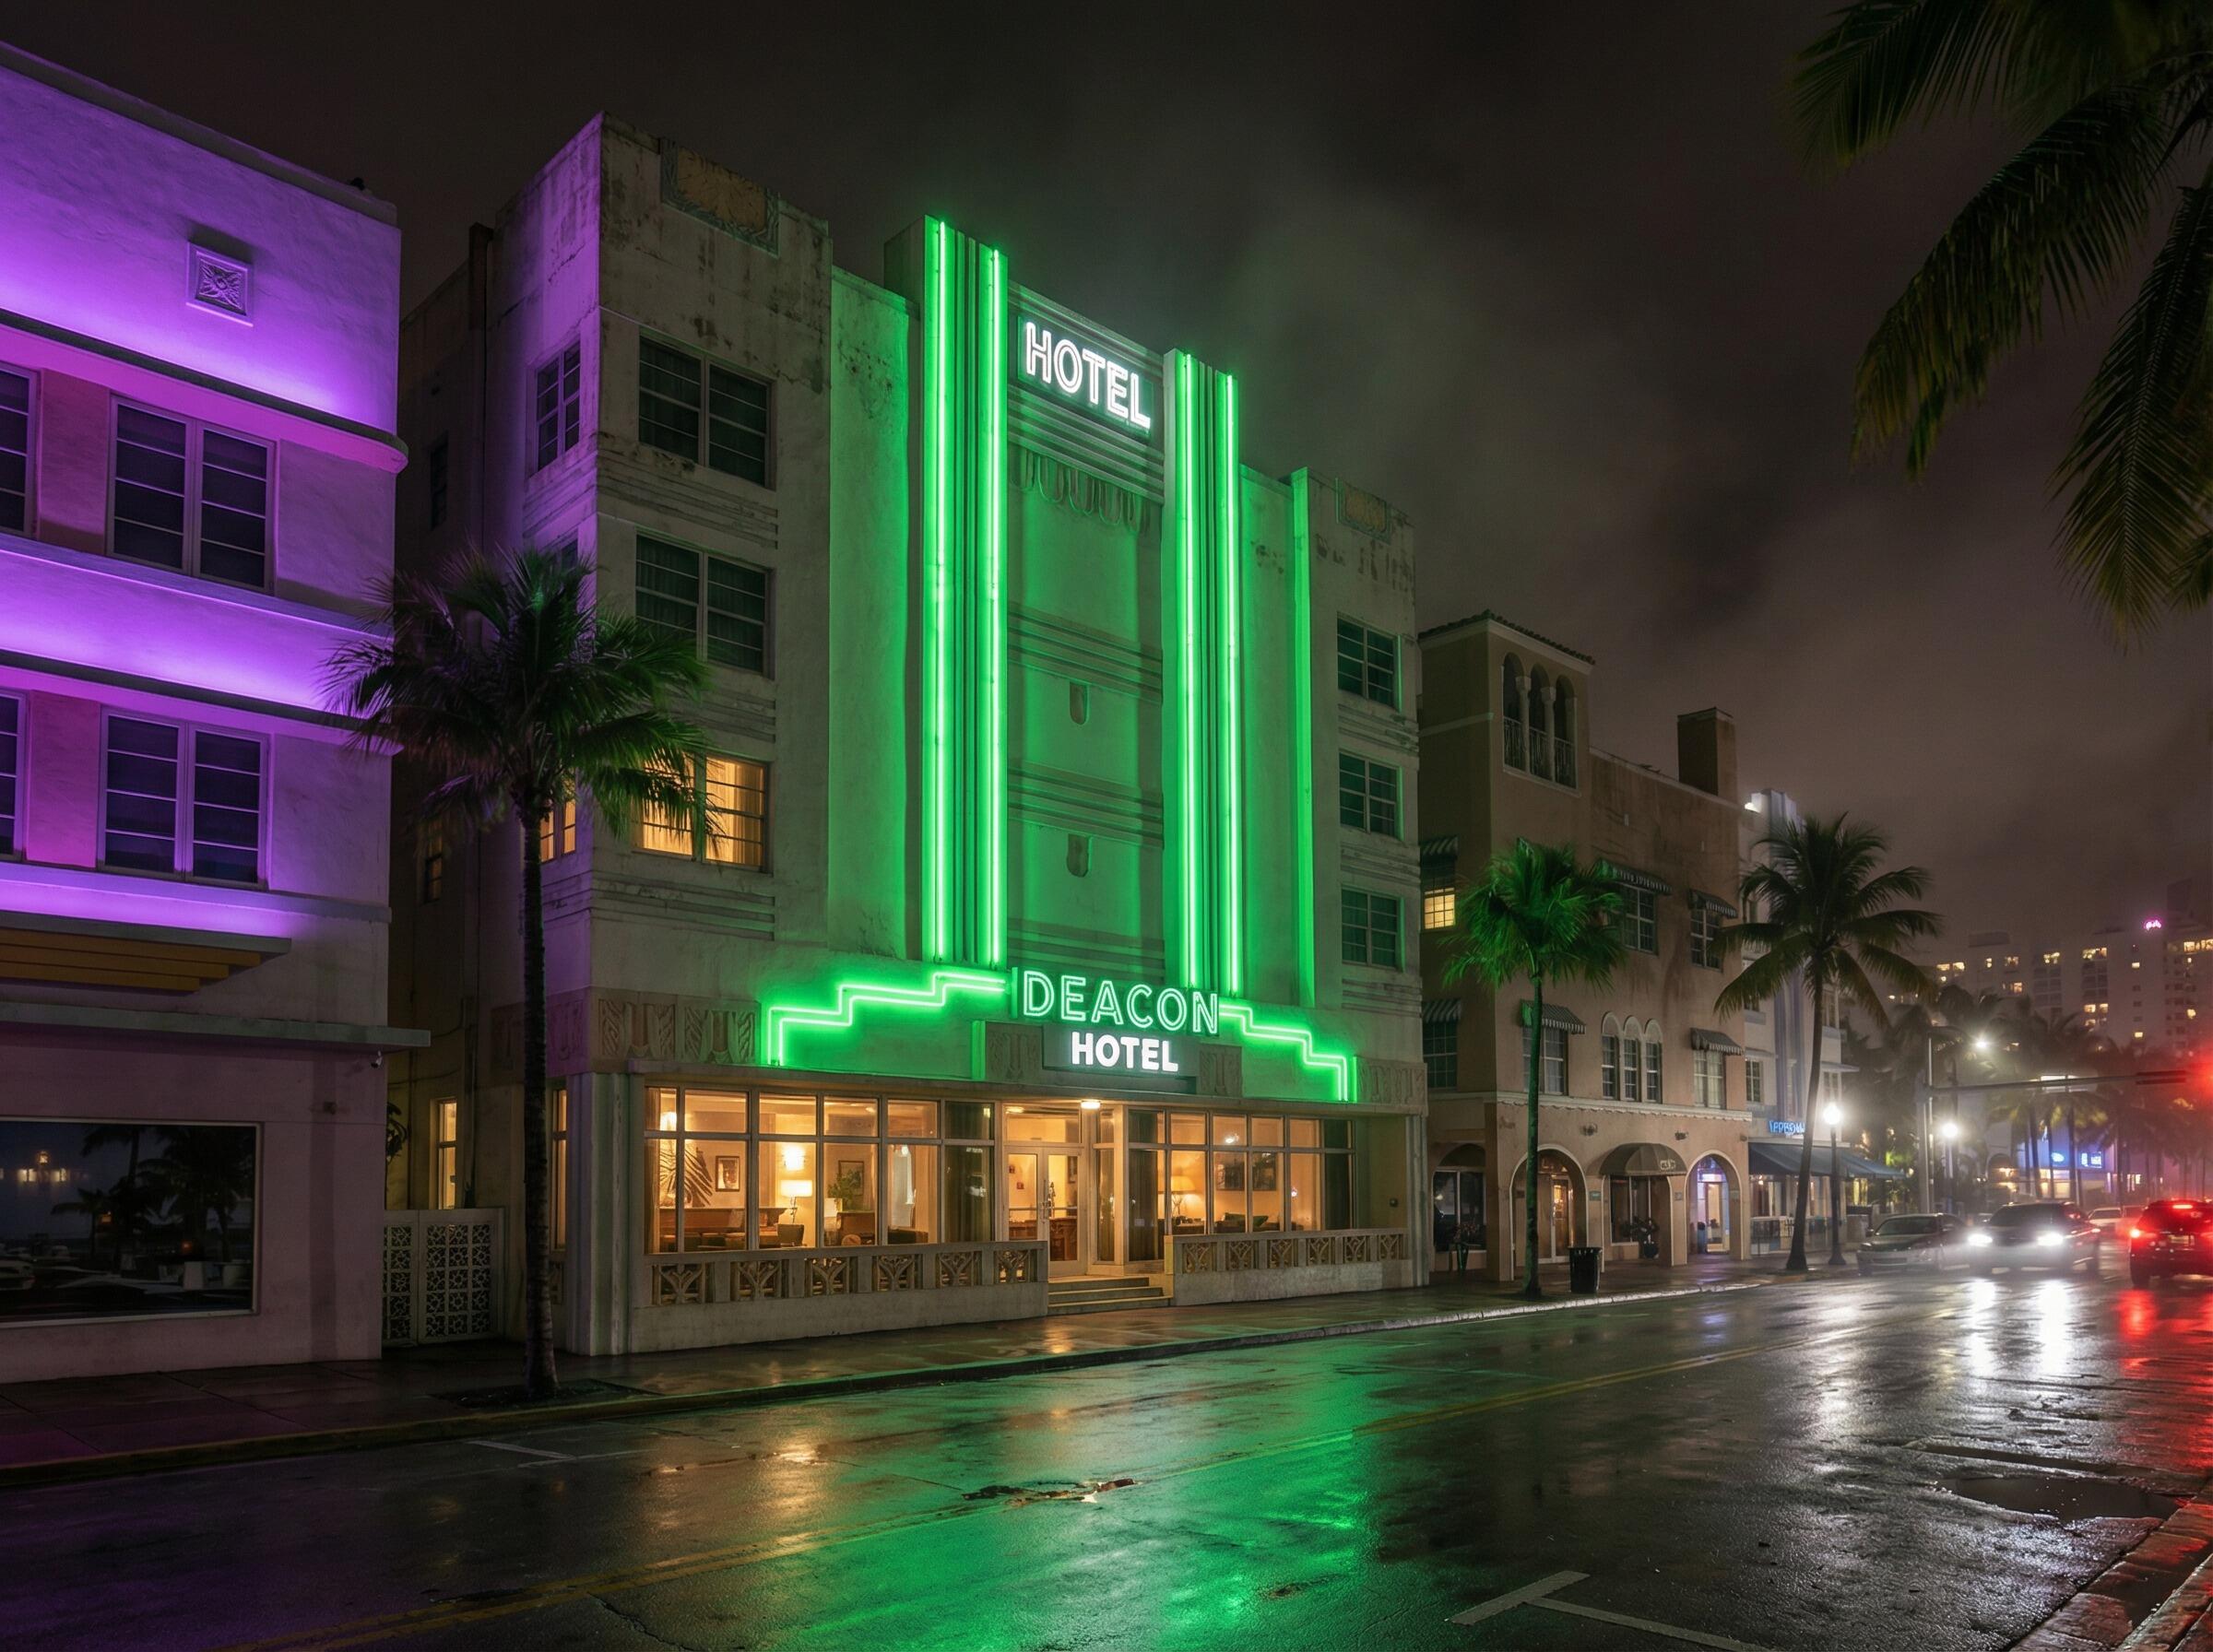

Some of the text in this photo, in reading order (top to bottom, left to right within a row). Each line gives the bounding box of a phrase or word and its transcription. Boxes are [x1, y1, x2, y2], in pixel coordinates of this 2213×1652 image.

[1025, 321, 1151, 430] HOTEL
[1024, 971, 1218, 1034] DEACON
[1071, 1031, 1179, 1072] HOTEL
